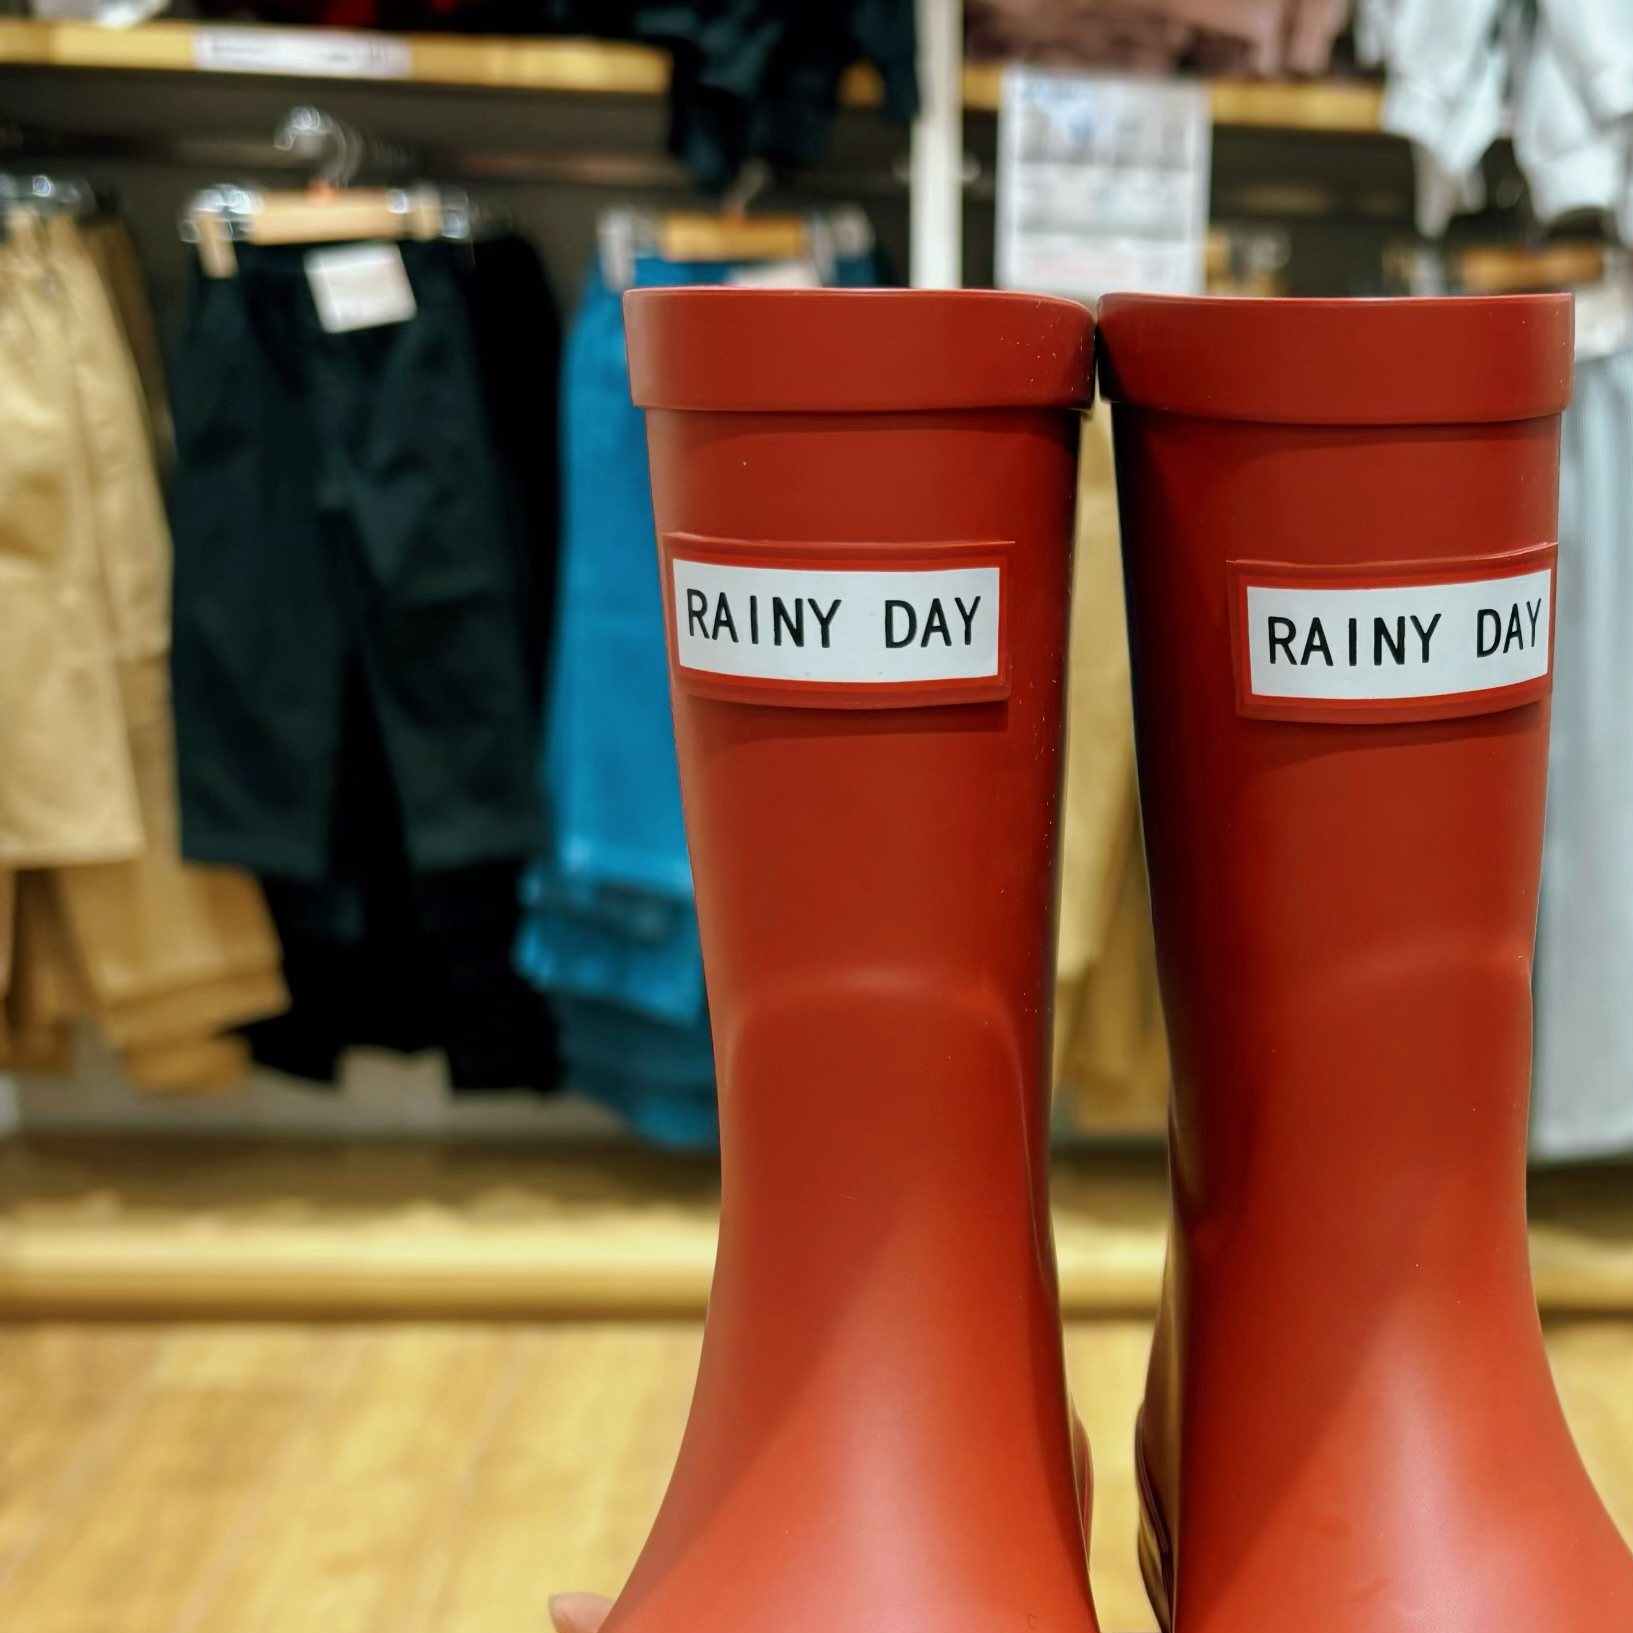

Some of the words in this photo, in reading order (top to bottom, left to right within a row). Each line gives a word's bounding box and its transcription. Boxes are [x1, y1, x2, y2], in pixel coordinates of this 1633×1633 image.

[685, 587, 843, 650] RAINY
[883, 594, 982, 650] DAY
[1266, 612, 1443, 668] RAINY
[1475, 597, 1543, 659] DAY
